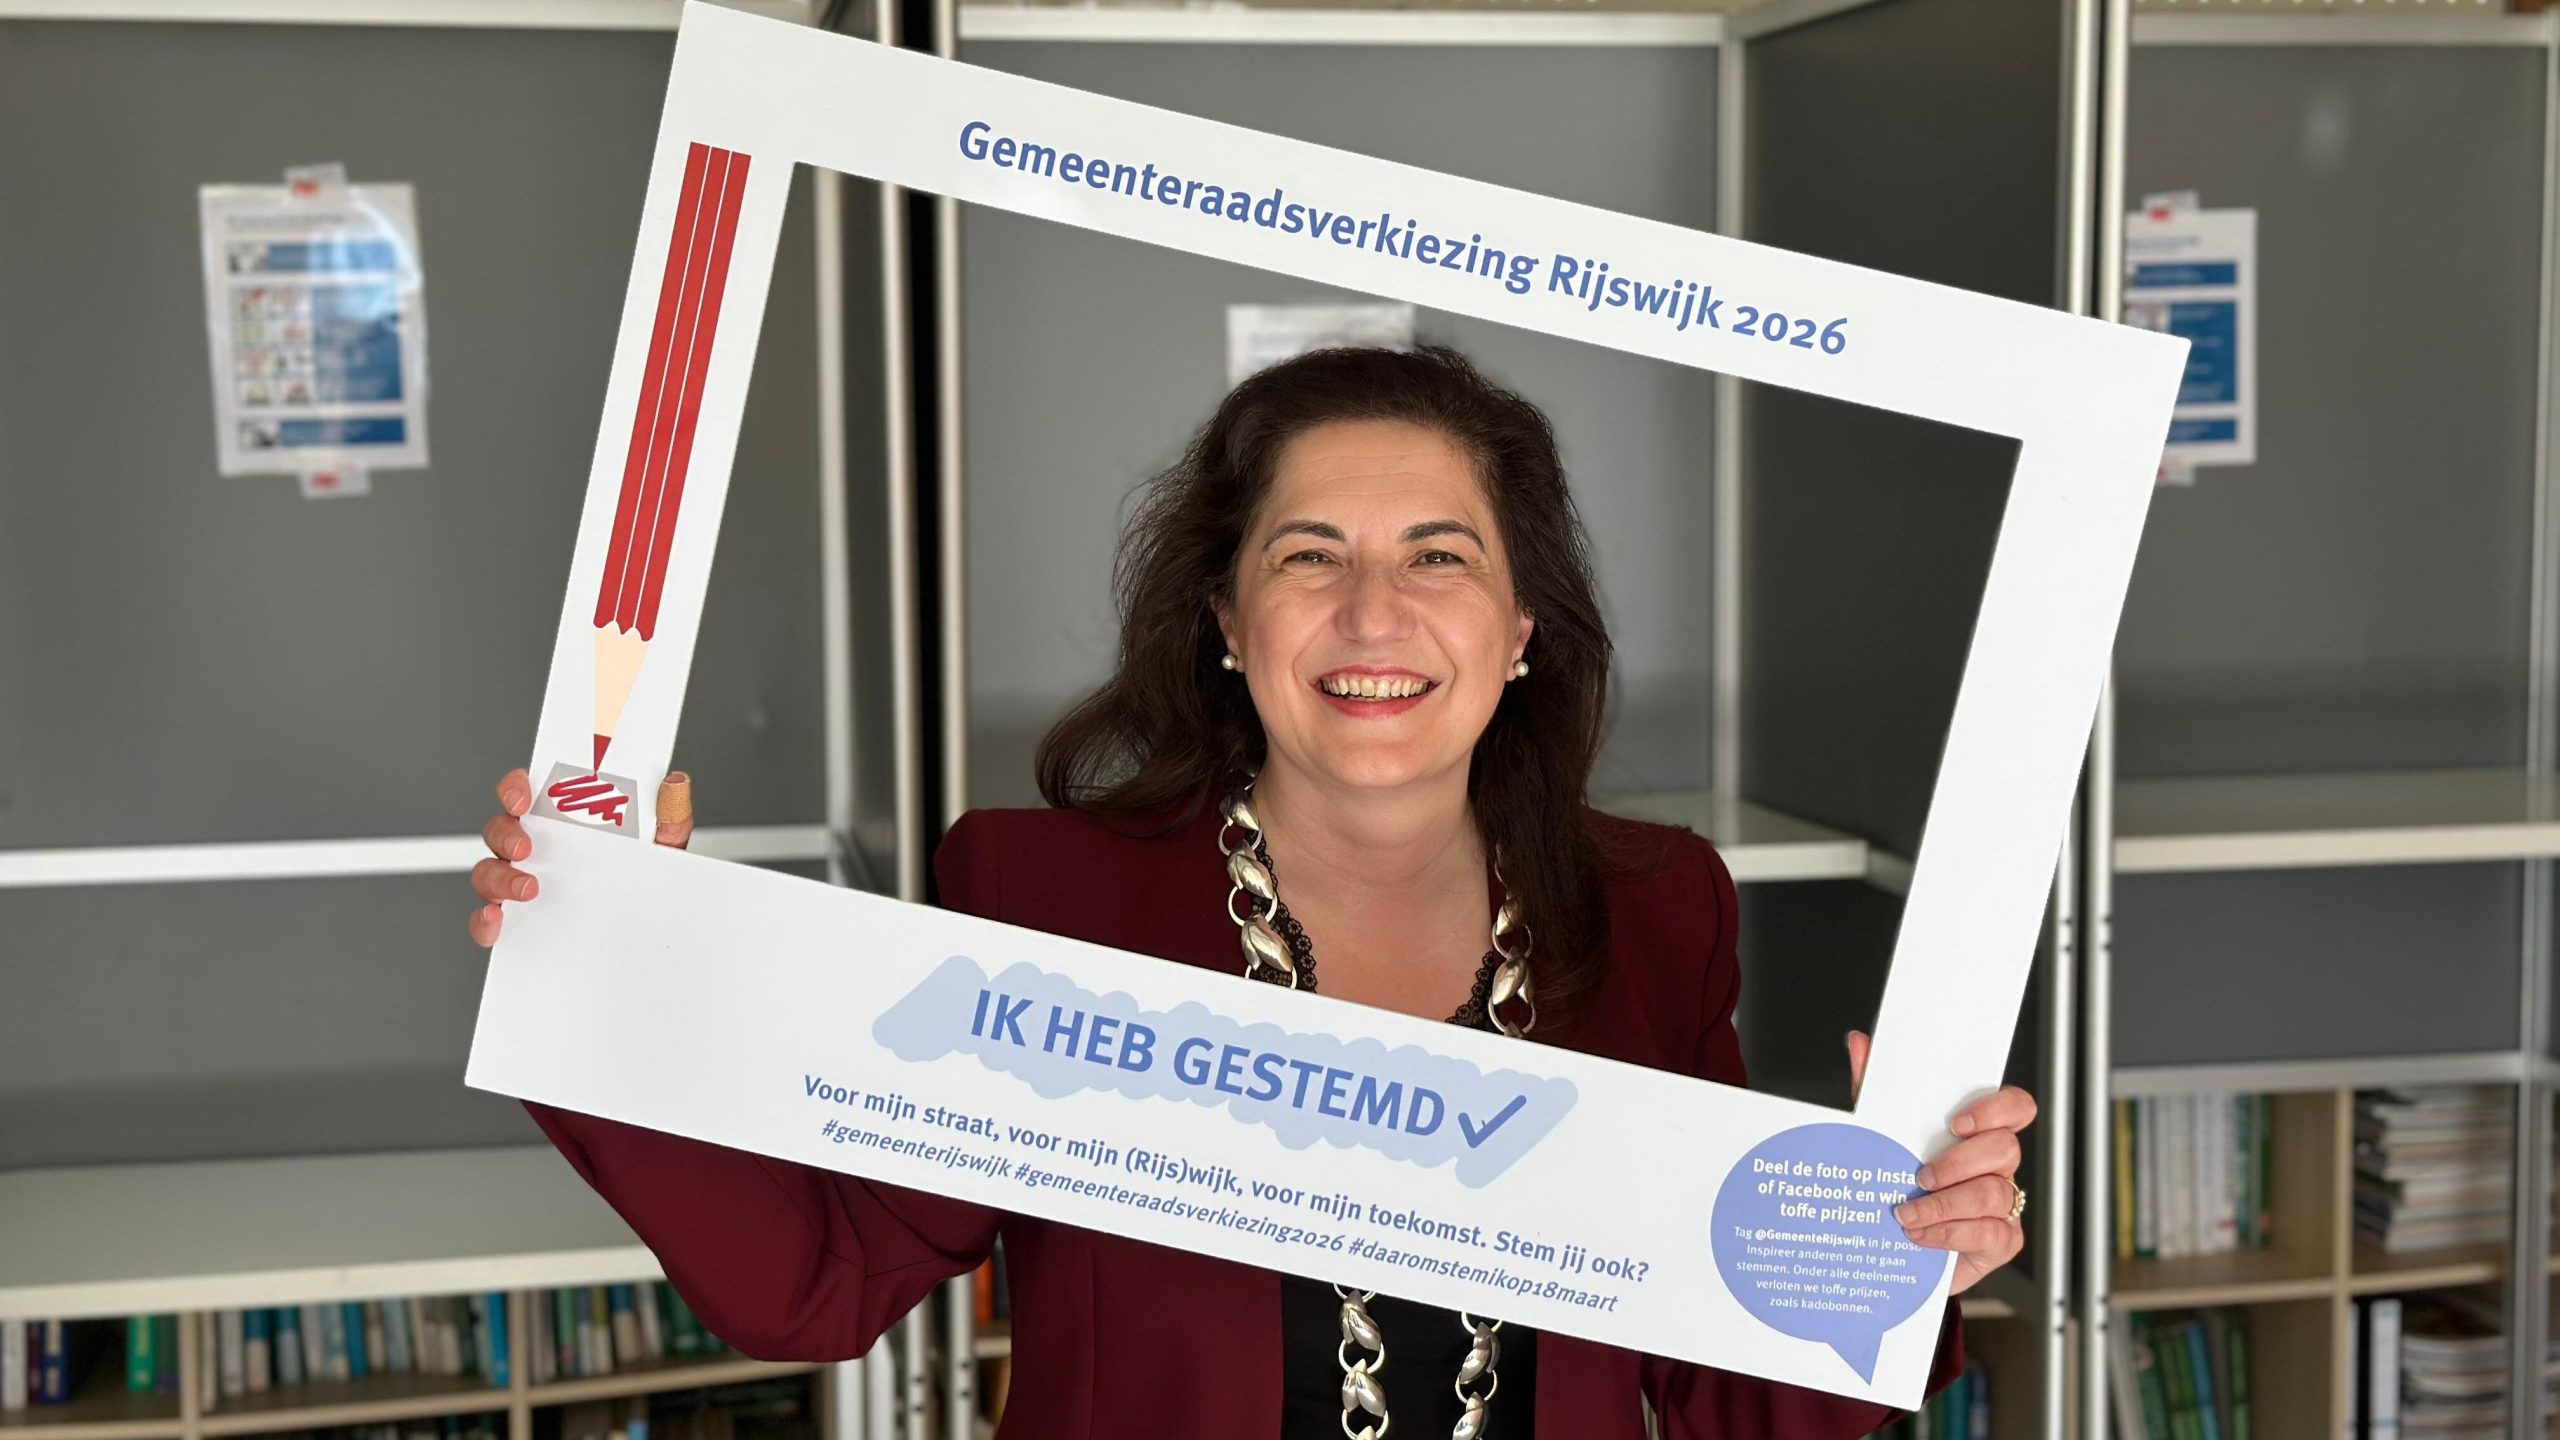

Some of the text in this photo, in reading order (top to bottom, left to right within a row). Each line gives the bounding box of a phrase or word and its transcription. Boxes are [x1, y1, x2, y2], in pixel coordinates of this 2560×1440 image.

[960, 121, 1848, 355] Gemeenteraadsverkiezing Rijswijk 2026
[970, 989, 1446, 1136] IK HEB GESTEMD
[804, 1075, 1650, 1283] Voor mijn straat, voor mijn (Rijs)wijk, voor mijn toekomst. Stem jij ook?
[1753, 1158, 1916, 1185] Deel de foto op Insta
[1758, 1179, 1907, 1204] of Facebook en win
[821, 1119, 1619, 1313] #gemeenterijswijk #gemeenteraadsverkiezing2026 #daaromstemikop18maart
[1780, 1202, 1882, 1224] toffe prijzen!
[1734, 1226, 1752, 1239] Tag
[1755, 1228, 1866, 1249] @GemeenteRijswijk
[1868, 1237, 1879, 1248] in
[1880, 1238, 1892, 1251] je
[1747, 1244, 1906, 1267] Inspireer anderen om te gaan
[1736, 1261, 1918, 1285] stemmen. Onder alle deelnemers
[1756, 1279, 1891, 1300] verloten we toffe prijzen,
[1769, 1297, 1874, 1314] zoals kadobonnen.
